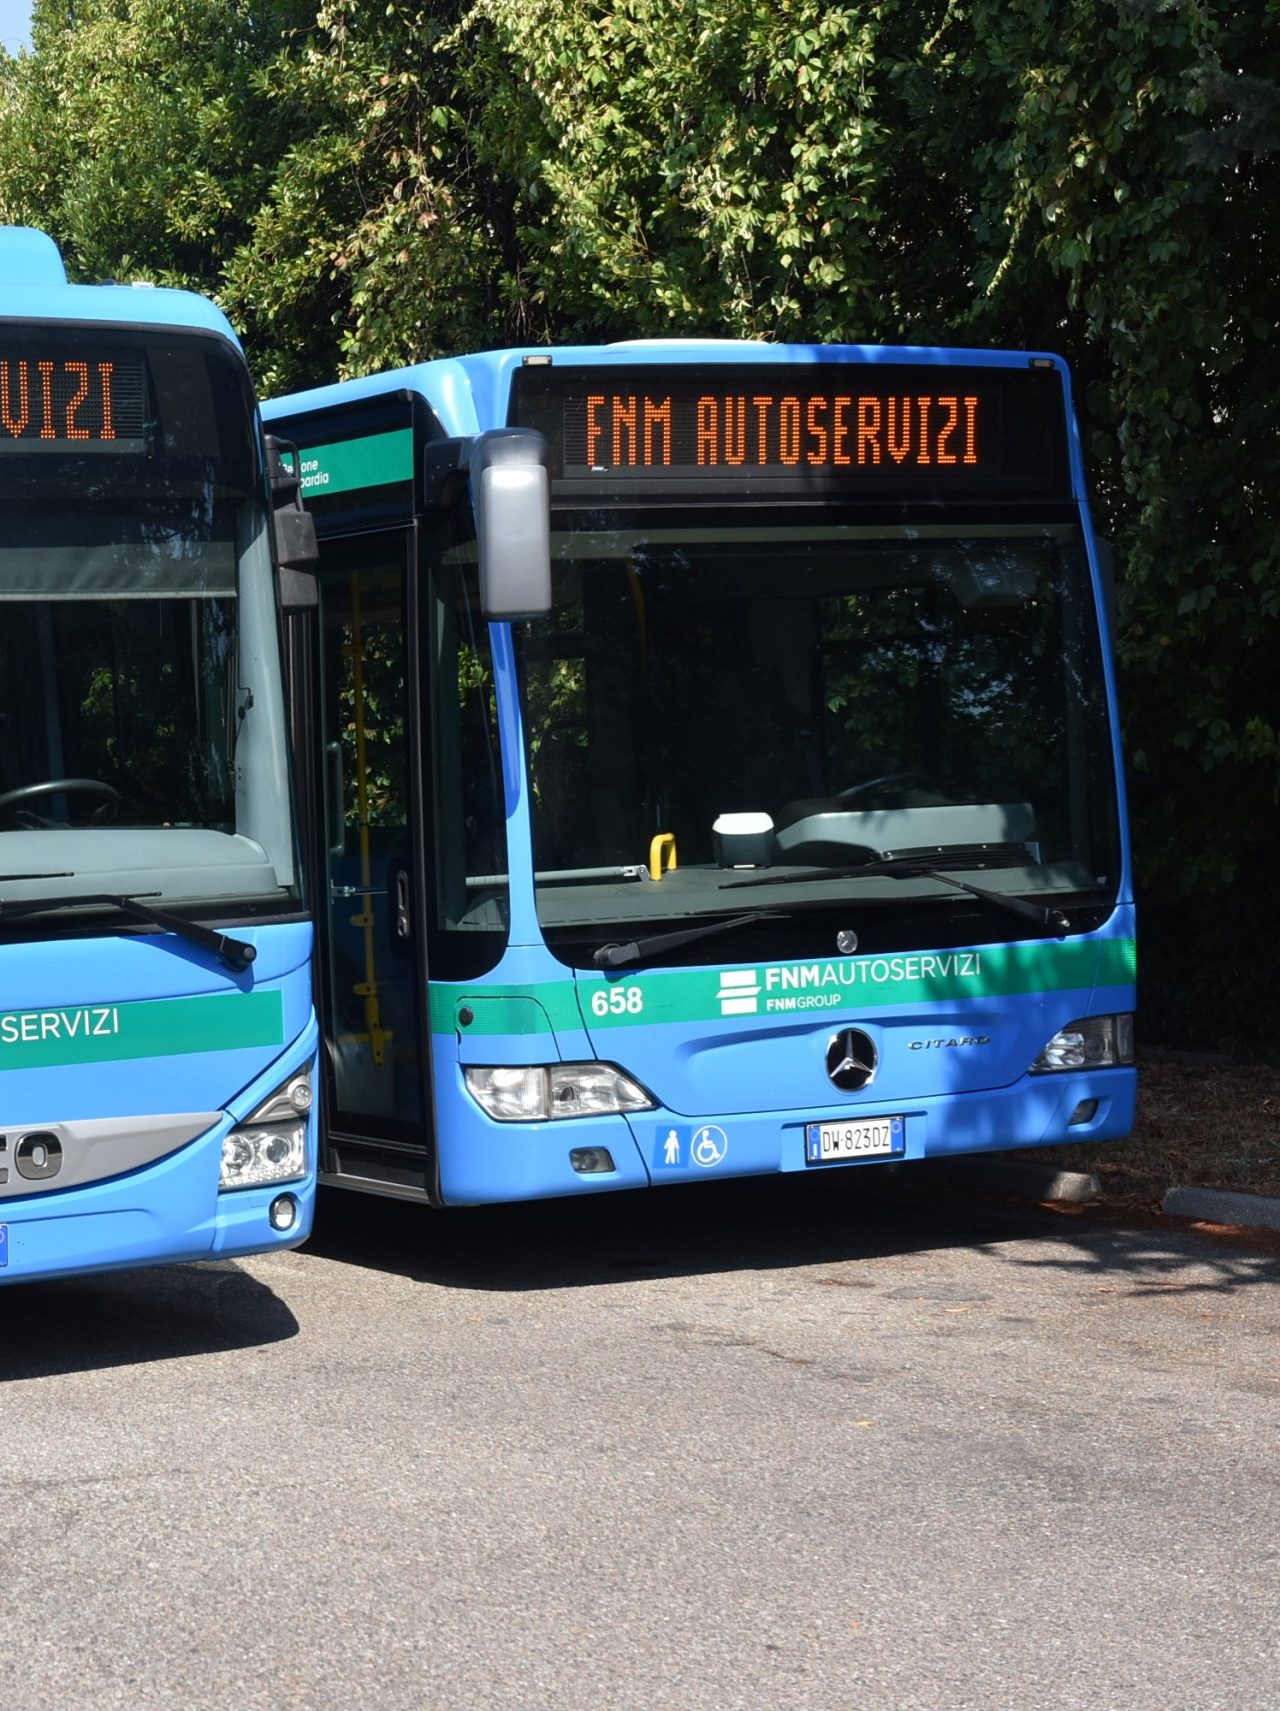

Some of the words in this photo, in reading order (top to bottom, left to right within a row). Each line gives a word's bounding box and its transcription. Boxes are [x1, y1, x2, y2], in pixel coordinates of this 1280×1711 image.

[587, 396, 671, 466] FNM
[697, 397, 978, 465] AUTOSERVIZI
[766, 954, 981, 990] FNMAUTOSERVIZI
[591, 986, 643, 1016] 658
[766, 994, 841, 1011] FNMGROUP
[908, 1035, 991, 1051] CITARO
